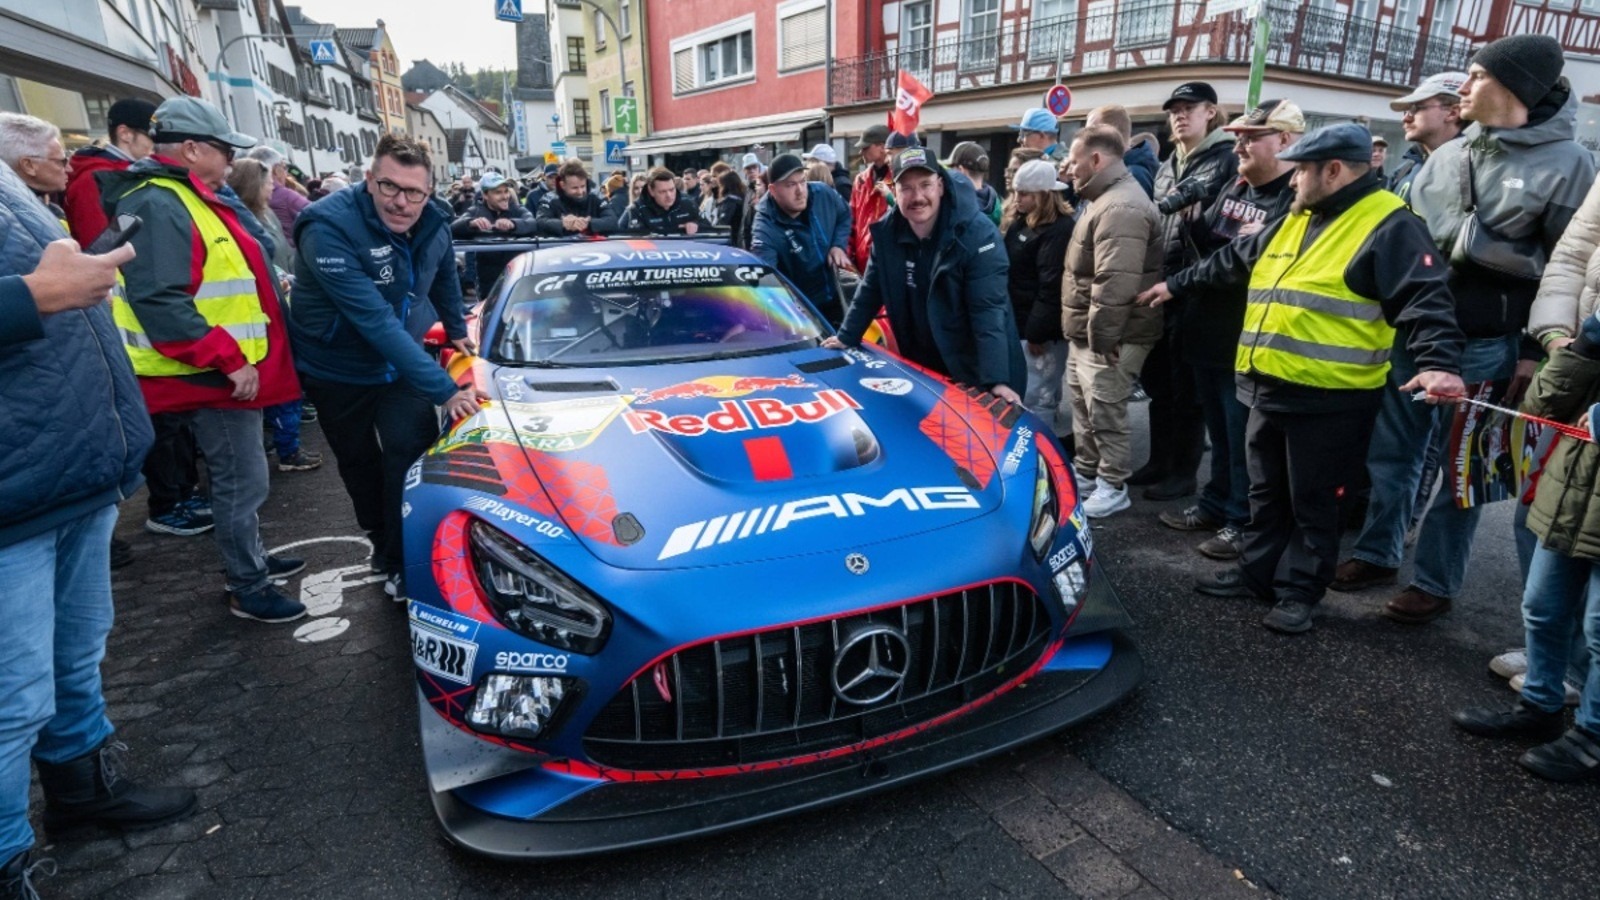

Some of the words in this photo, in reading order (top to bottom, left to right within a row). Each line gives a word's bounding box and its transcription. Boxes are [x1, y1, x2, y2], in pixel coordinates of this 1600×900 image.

[617, 249, 720, 262] viaplay
[586, 270, 638, 284] GRAN
[643, 266, 721, 281] TURISMO
[621, 399, 752, 436] Red
[743, 388, 864, 429] Bull
[523, 416, 553, 433] 3
[482, 429, 576, 448] DEKRA
[772, 486, 981, 531] AMG
[1049, 542, 1077, 571] sparco
[418, 611, 470, 633] MICHELIN
[494, 651, 568, 671] sparco
